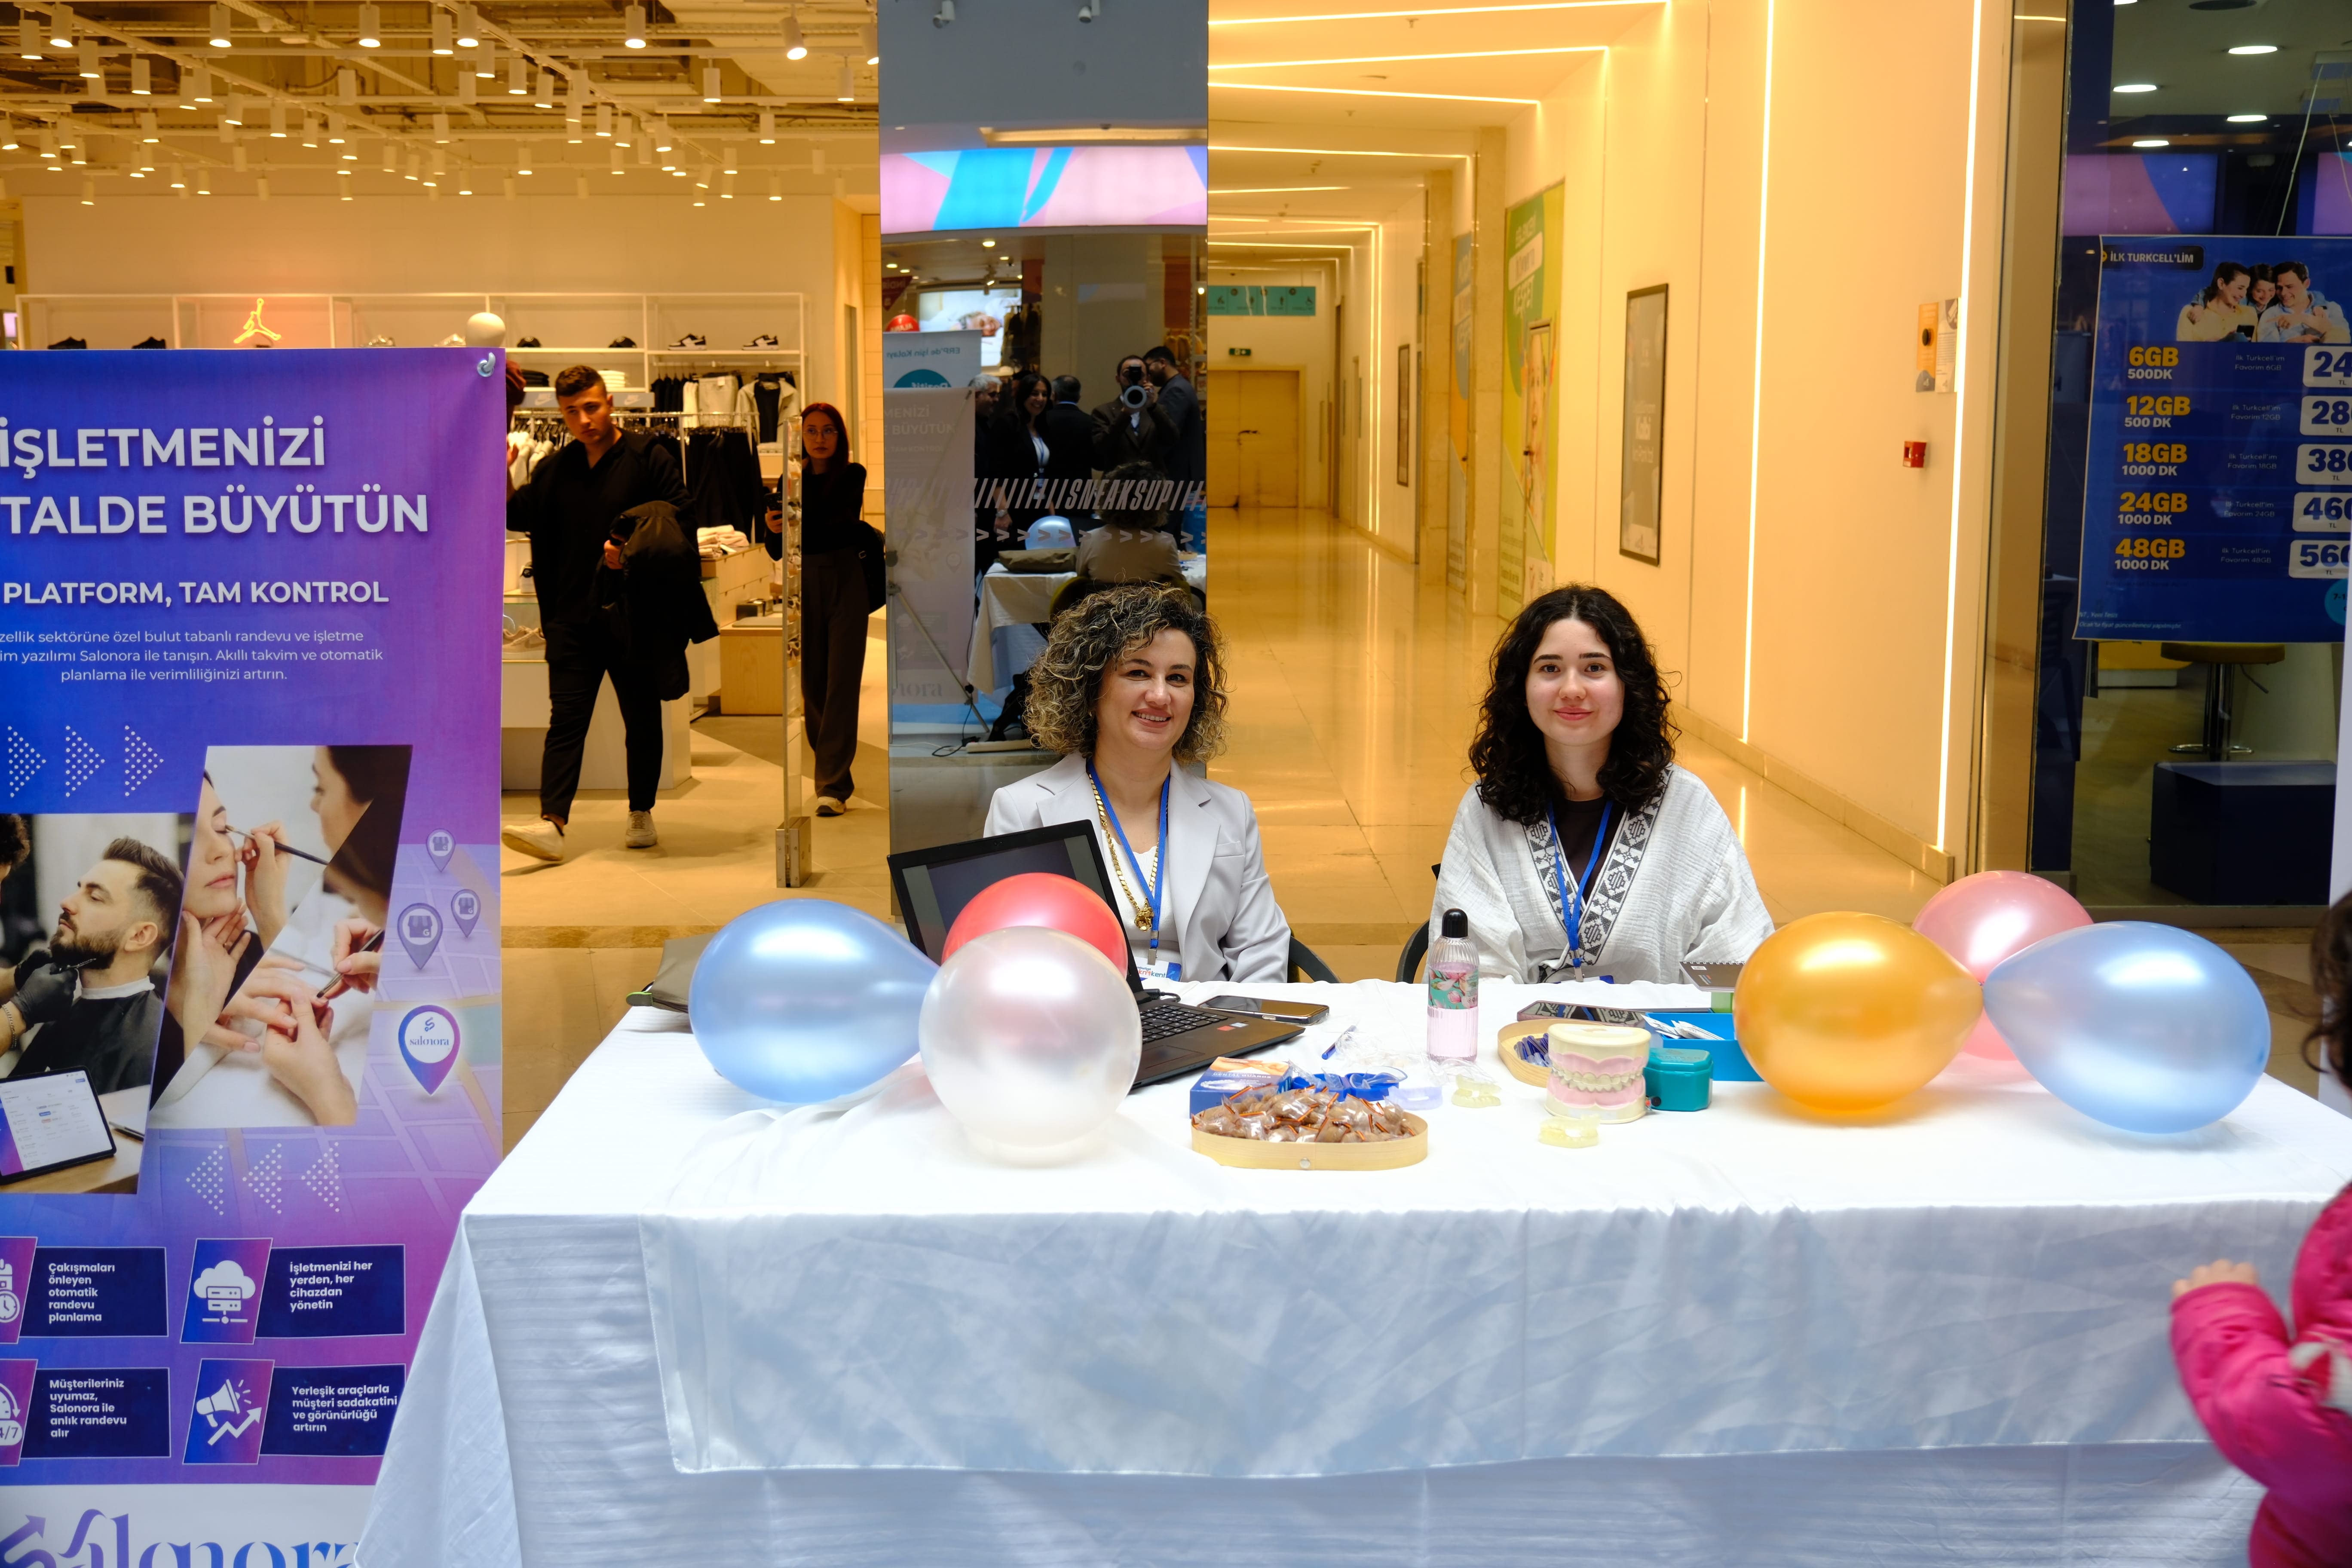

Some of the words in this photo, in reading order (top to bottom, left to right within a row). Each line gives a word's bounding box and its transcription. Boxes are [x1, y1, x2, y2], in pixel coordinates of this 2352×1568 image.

[2110, 251, 2125, 262] İLK
[2127, 252, 2193, 263] TURKCELL'LİM
[2129, 346, 2179, 367] 6GB
[2126, 395, 2190, 416] 12GB
[2312, 401, 2352, 425] 28
[2125, 417, 2150, 427] 500
[2153, 417, 2171, 428] DK
[2123, 443, 2187, 463] 18GB
[2122, 465, 2156, 475] 1000
[2159, 465, 2177, 476] DK
[184, 483, 428, 533] BÜYÜTÜN
[2119, 492, 2187, 512] 24GB
[2118, 514, 2151, 524] 1000
[2153, 514, 2172, 525] DK
[2115, 538, 2185, 558] 48GB
[2114, 559, 2149, 570] 1000
[2151, 560, 2169, 570] DK
[4, 582, 172, 607] PLATFORM,
[178, 582, 241, 603] TAM
[251, 581, 389, 603] KONTROL
[38, 631, 110, 642] sektörüne
[113, 631, 140, 642] özel
[145, 631, 181, 642] bulut
[184, 630, 231, 642] tabanlı
[236, 630, 291, 641] randevu
[294, 633, 310, 641] ve
[314, 630, 364, 644] işletme
[21, 650, 75, 664] yazılımı
[80, 650, 140, 662] Salonora
[145, 649, 160, 661] ile
[163, 649, 212, 664] tanışın.
[215, 649, 248, 661] Akıllı
[251, 649, 297, 660] takvim
[301, 652, 317, 660] ve
[320, 649, 383, 660] otomatik
[61, 669, 126, 683] planlama
[131, 669, 146, 680] ile
[150, 668, 239, 682] verimliliğinizi
[244, 669, 287, 680] artırın.
[410, 1036, 449, 1045] salonora
[49, 1262, 115, 1274] Çakışmaları
[290, 1261, 351, 1274] İşletmenizi
[354, 1261, 373, 1270] her
[49, 1275, 92, 1287] önleyen
[290, 1274, 333, 1287] yerden,
[335, 1274, 355, 1283] her
[49, 1287, 98, 1297] otomatik
[290, 1286, 342, 1297] cihazdan
[49, 1300, 95, 1309] randevu
[290, 1298, 333, 1313] yönetin
[49, 1312, 102, 1324] planlama
[49, 1378, 124, 1391] Müşterileriniz
[292, 1385, 335, 1398] Yerleşik
[337, 1384, 389, 1396] araçlarla
[50, 1391, 98, 1403] uyumaz,
[292, 1397, 334, 1410] müşteri
[337, 1395, 398, 1407] sadakatini
[50, 1403, 100, 1413] Salonora
[102, 1403, 115, 1412] ile
[50, 1416, 78, 1425] anlık
[80, 1415, 127, 1425] randevu
[308, 1409, 377, 1423] görünürlüğü
[50, 1428, 69, 1437] alır
[293, 1422, 327, 1432] artırın
